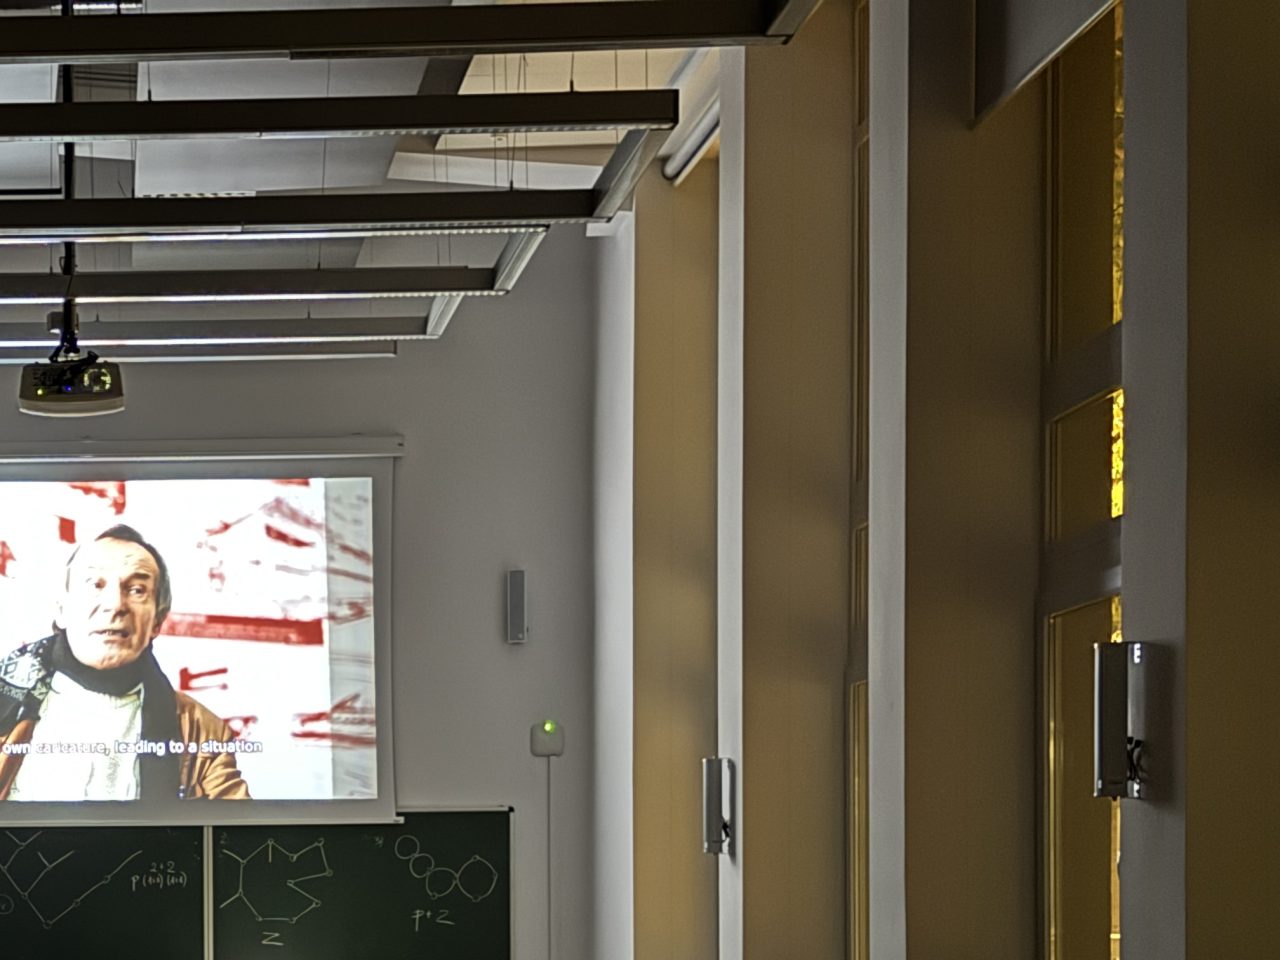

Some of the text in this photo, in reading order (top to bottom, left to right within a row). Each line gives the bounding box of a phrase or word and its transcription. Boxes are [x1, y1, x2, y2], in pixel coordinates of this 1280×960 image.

[3, 743, 32, 754] own
[114, 740, 166, 757] leading
[169, 741, 185, 754] to
[187, 743, 197, 754] a
[200, 740, 263, 754] situation
